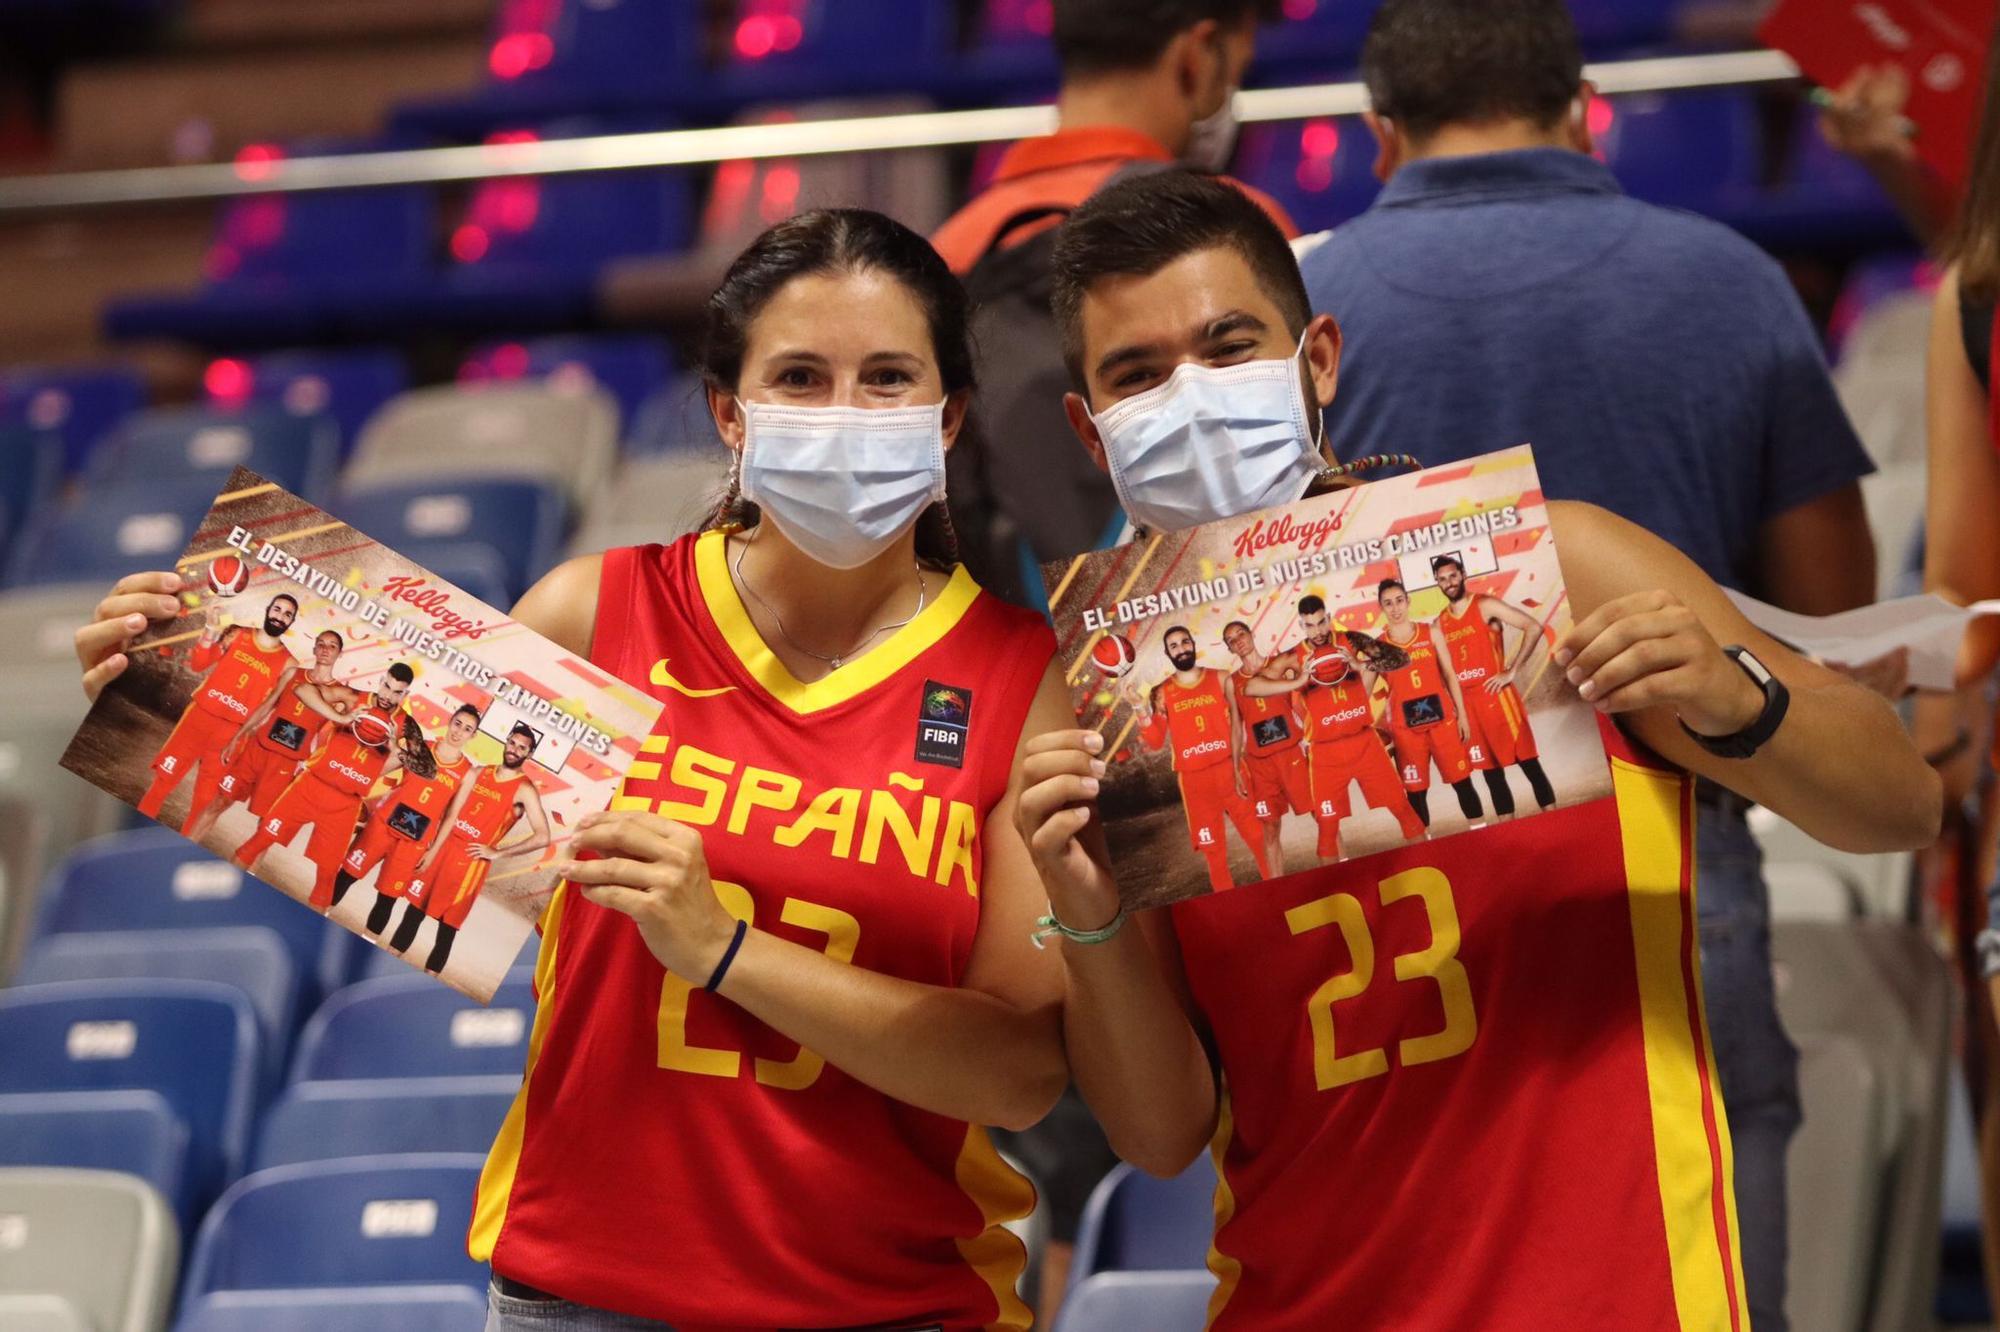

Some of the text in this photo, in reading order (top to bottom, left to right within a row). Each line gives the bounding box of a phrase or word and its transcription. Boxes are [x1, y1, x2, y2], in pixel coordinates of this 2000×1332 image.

[1233, 510, 1344, 558] Kellogg's
[1082, 505, 1519, 632] EL DESAYUNO DE NUESTROS CAMPEONES
[383, 576, 488, 639] Kellogg's
[226, 525, 255, 554] EL
[256, 542, 360, 612] DESAYUNO
[360, 601, 391, 630] DE
[390, 618, 494, 687] NUESTROS
[493, 676, 613, 756] CAMPEONES
[236, 673, 249, 689] 9
[1410, 669, 1422, 689] 6
[208, 689, 249, 716] endesa
[1330, 686, 1348, 705] 14
[1195, 715, 1206, 732] 9
[1322, 705, 1367, 726] endesa
[924, 728, 959, 745] FIBA
[1183, 740, 1227, 759] endesa
[329, 760, 372, 785] endesa
[418, 787, 433, 804] 6
[609, 735, 979, 898] ESPAÑA
[1284, 866, 1478, 1092] 23
